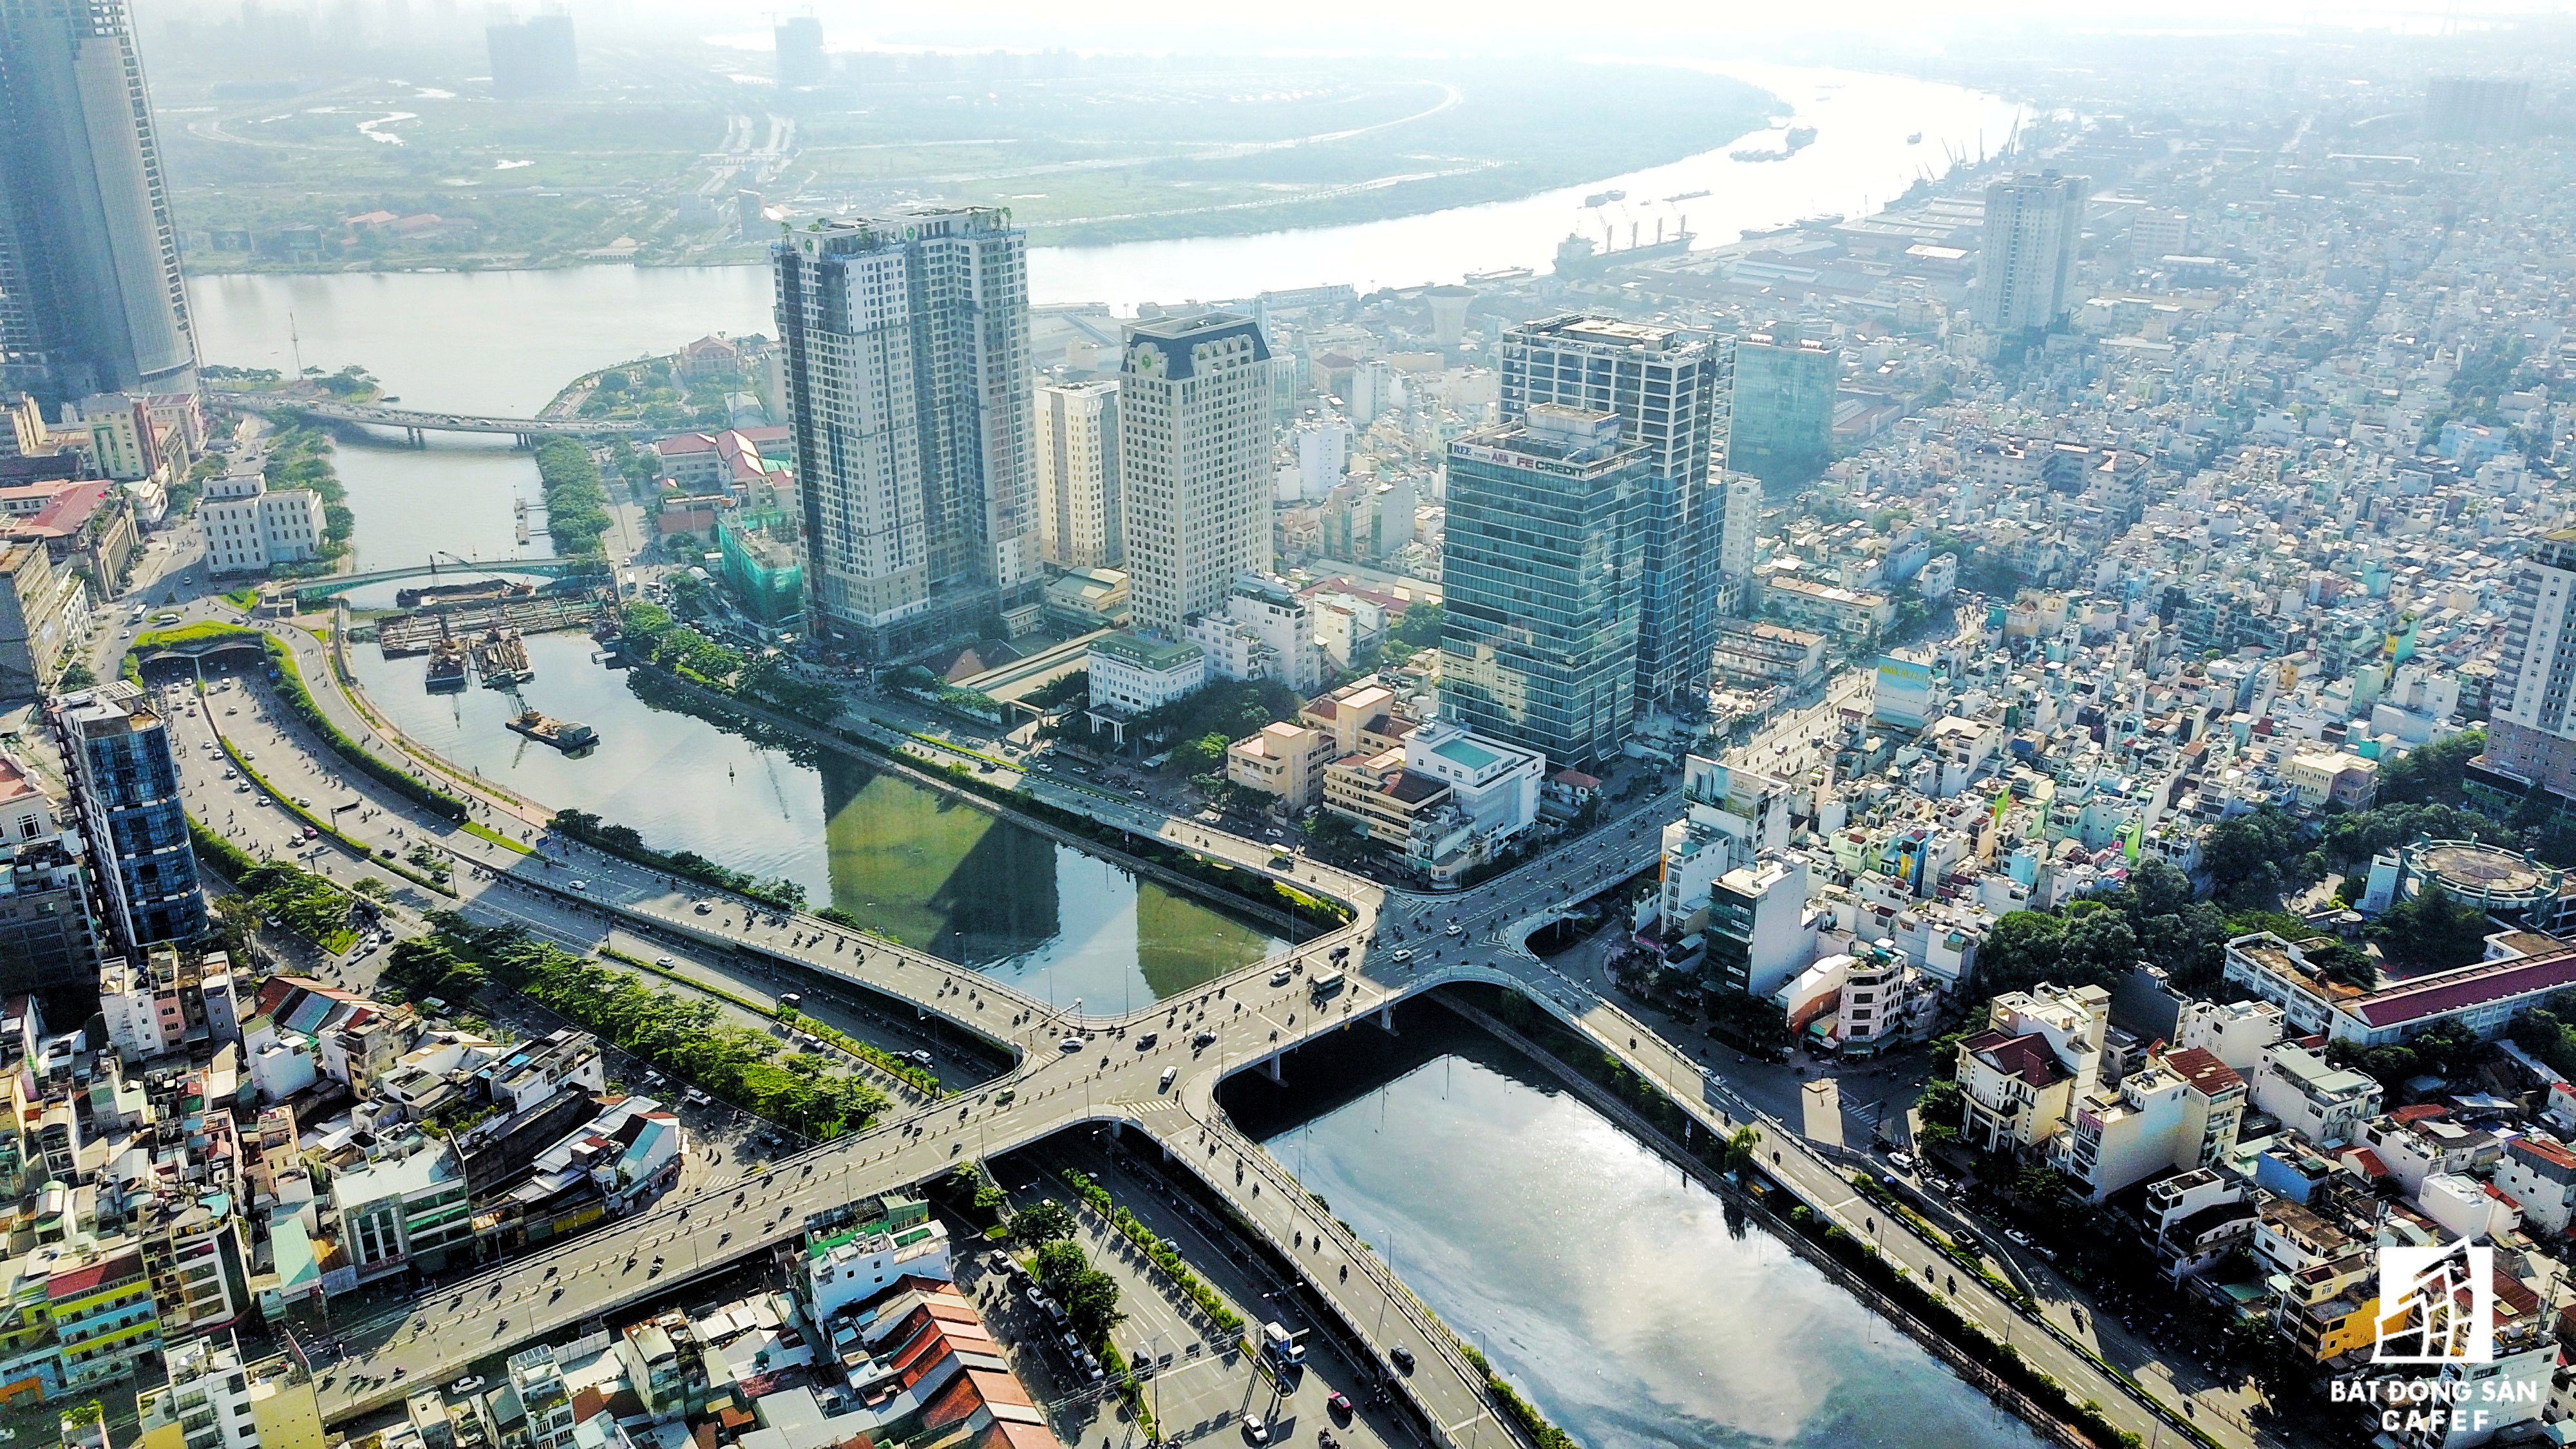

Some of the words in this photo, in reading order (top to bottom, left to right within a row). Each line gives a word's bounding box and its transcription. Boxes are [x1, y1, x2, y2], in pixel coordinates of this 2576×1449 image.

[1454, 444, 1472, 455] REE
[1492, 452, 1508, 463] ABB
[1517, 457, 1533, 468] FE
[1535, 460, 1586, 477] CREDIT
[1733, 779, 1750, 791] 30%
